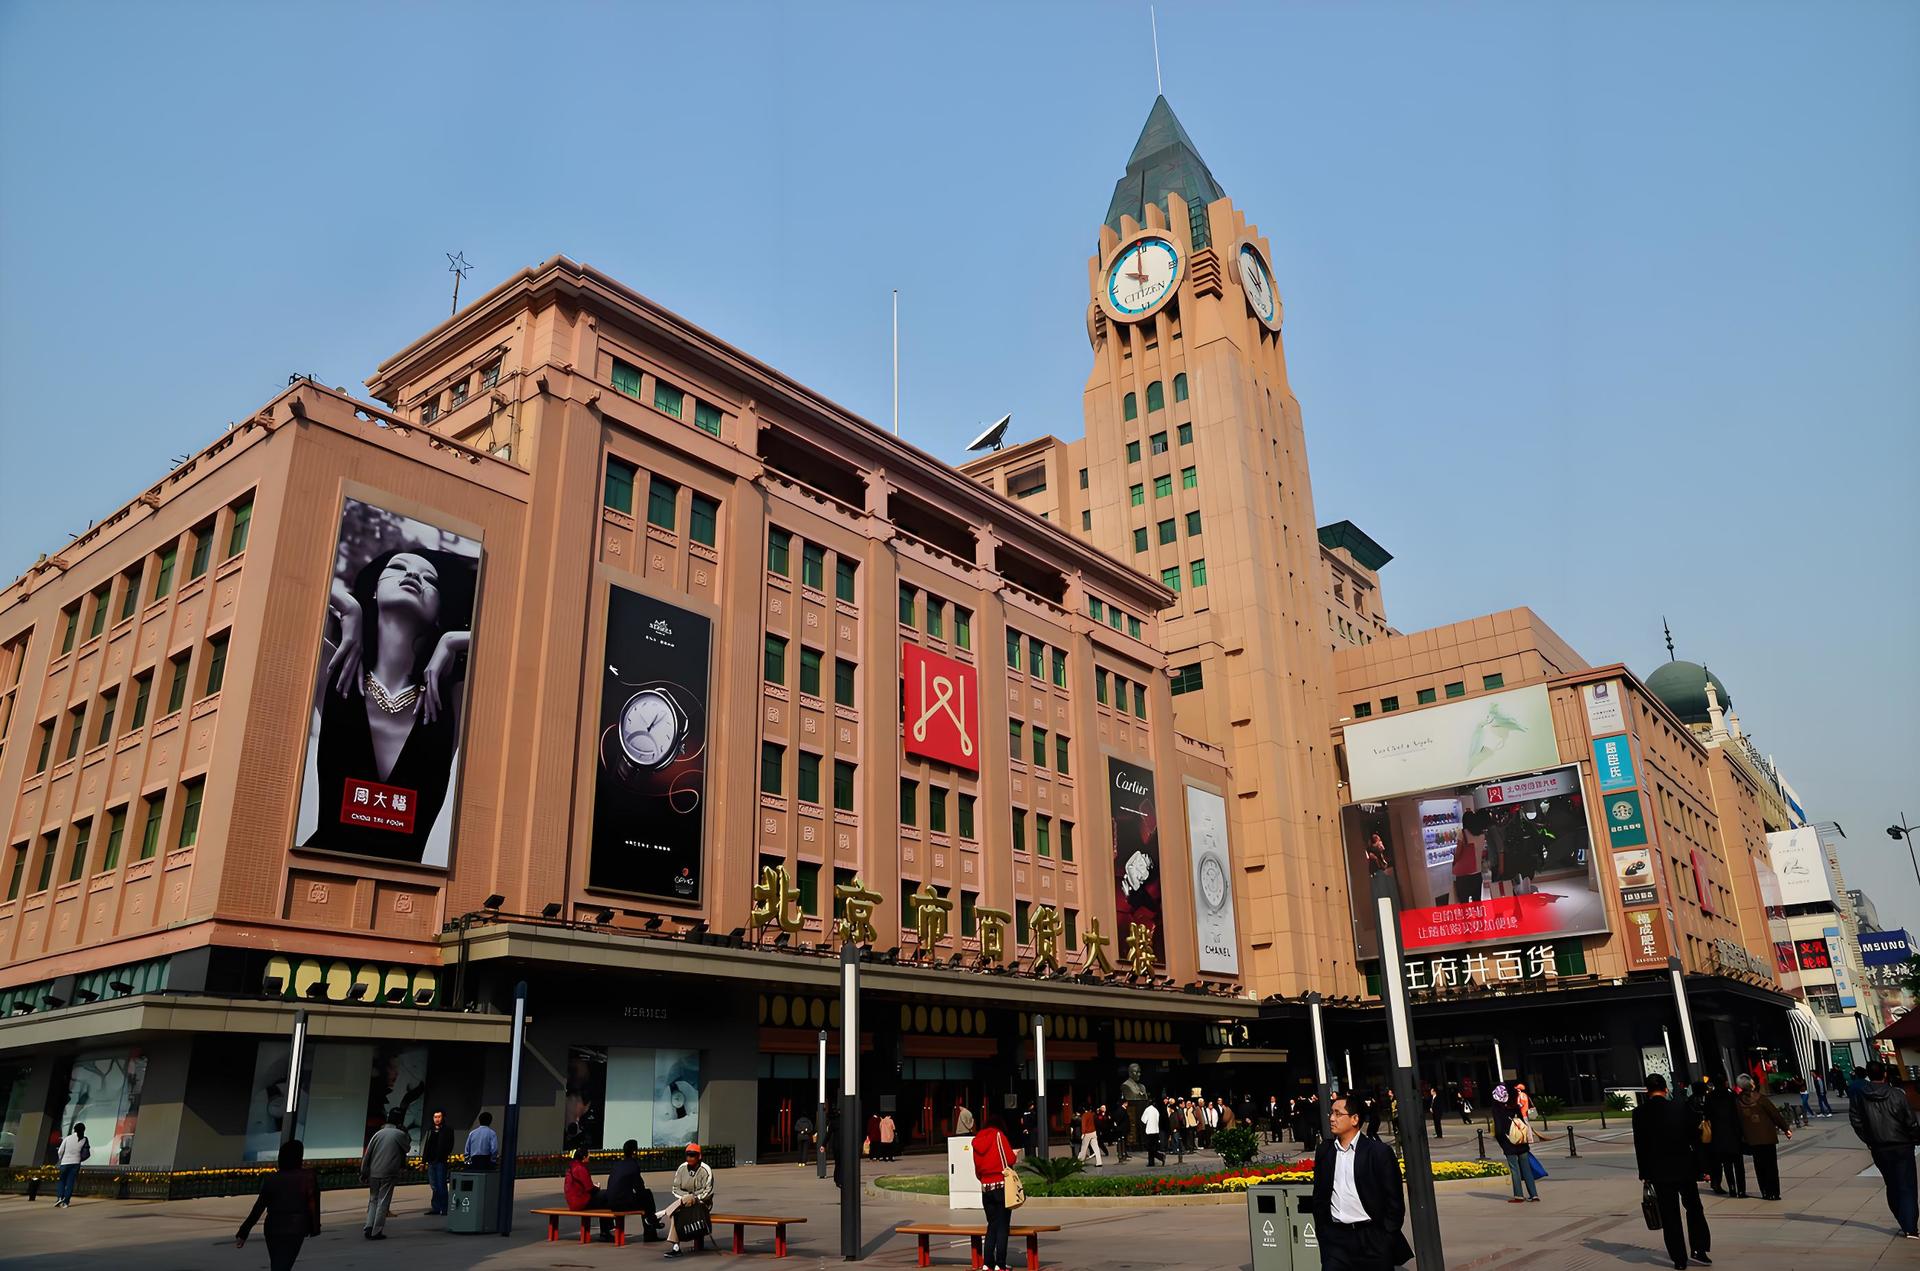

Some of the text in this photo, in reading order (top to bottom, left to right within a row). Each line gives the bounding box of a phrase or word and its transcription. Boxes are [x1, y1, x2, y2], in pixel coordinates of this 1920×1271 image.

[1125, 280, 1165, 304] CITIZEN
[1116, 771, 1149, 796] Cartier
[353, 787, 407, 811] 周大福
[1405, 945, 1558, 990] 王府井百货
